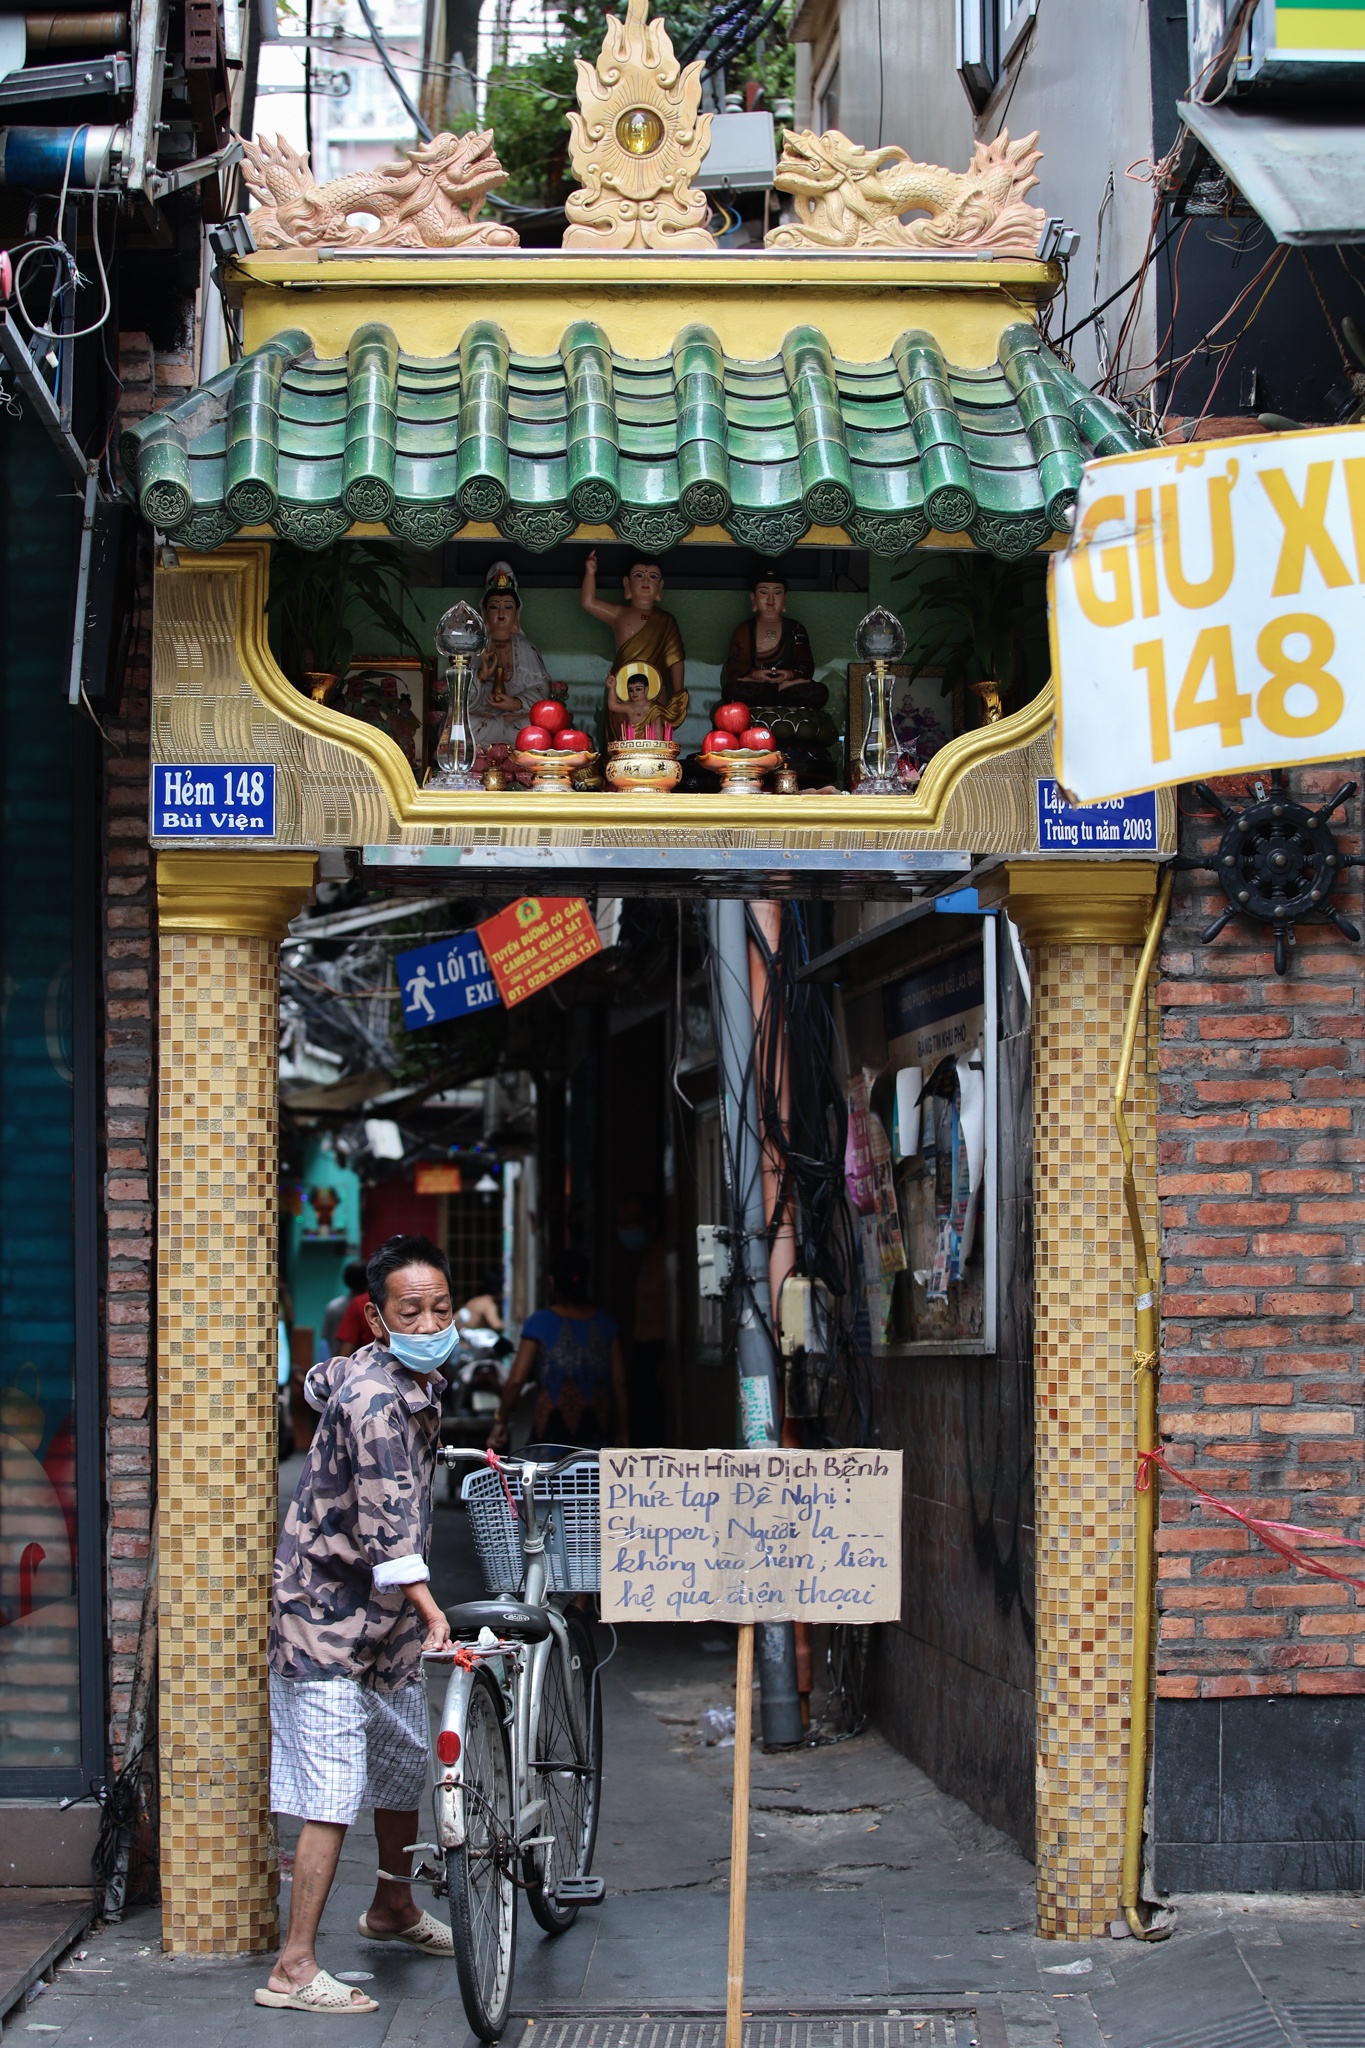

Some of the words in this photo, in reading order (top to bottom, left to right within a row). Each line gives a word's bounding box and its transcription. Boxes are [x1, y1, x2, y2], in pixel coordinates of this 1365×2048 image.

[1070, 449, 1239, 628] GIỮ
[1133, 612, 1345, 765] 148
[164, 769, 215, 806] Hẻm
[223, 771, 265, 806] 148
[162, 812, 202, 828] Bùi
[209, 812, 265, 831] Viện
[1044, 818, 1079, 846] Trùng
[1081, 821, 1093, 840] tu
[1095, 819, 1121, 841] năm
[1123, 818, 1152, 841] 2003
[436, 945, 467, 987] LỐI
[502, 946, 540, 975] CAMERA
[539, 928, 565, 952] QUAN
[564, 917, 583, 936] SÁT
[527, 938, 598, 989] 028.38369.131
[768, 1456, 818, 1483] Dịch
[824, 1455, 889, 1484] Bệnh
[605, 1480, 674, 1510] Phức
[675, 1481, 720, 1523] tạp
[728, 1515, 801, 1553] Người
[812, 1509, 840, 1545] lạ
[609, 1547, 696, 1589] không
[704, 1551, 746, 1570] vào
[834, 1541, 888, 1568] liên
[613, 1580, 657, 1613] hệ
[666, 1590, 719, 1619] qua
[726, 1580, 786, 1609] điện
[794, 1576, 877, 1610] thoại
